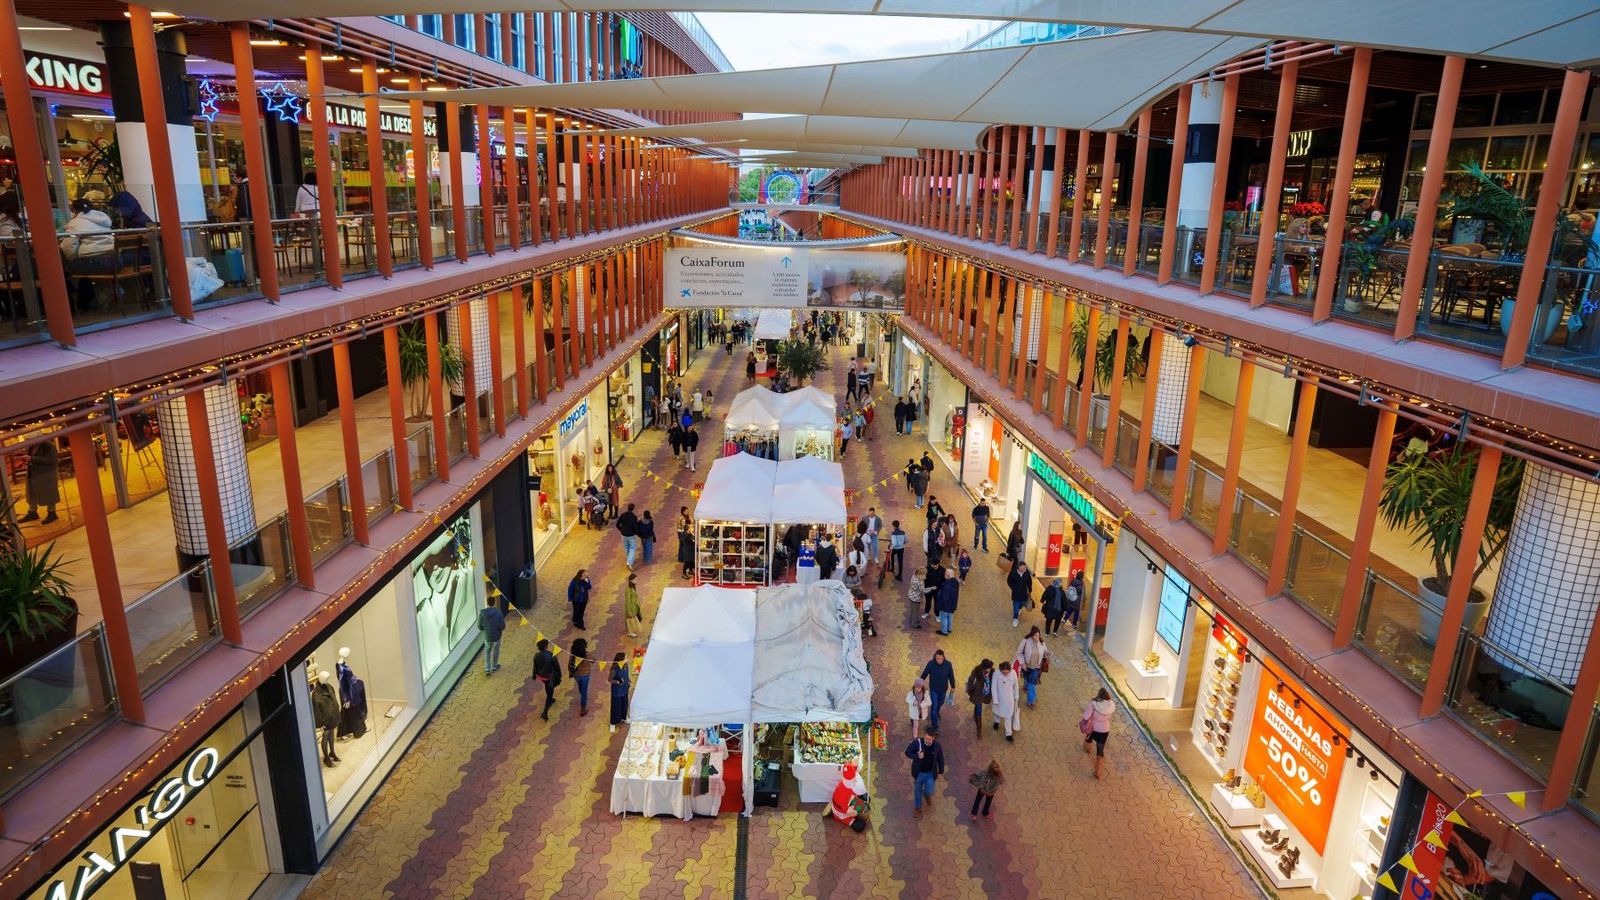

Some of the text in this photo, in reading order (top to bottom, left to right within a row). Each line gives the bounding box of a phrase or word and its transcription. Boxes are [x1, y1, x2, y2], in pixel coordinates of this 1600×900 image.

[26, 56, 102, 93] KING
[327, 105, 334, 122] A
[336, 106, 349, 125] LA
[394, 116, 412, 133] DESD
[680, 256, 745, 268] CaixaForum
[560, 398, 588, 436] mayoral
[1031, 453, 1095, 526] DEICHMANN
[1267, 711, 1326, 773] AHORA HASTA
[1268, 688, 1333, 757] REBAJAS
[1260, 735, 1321, 806] -50%
